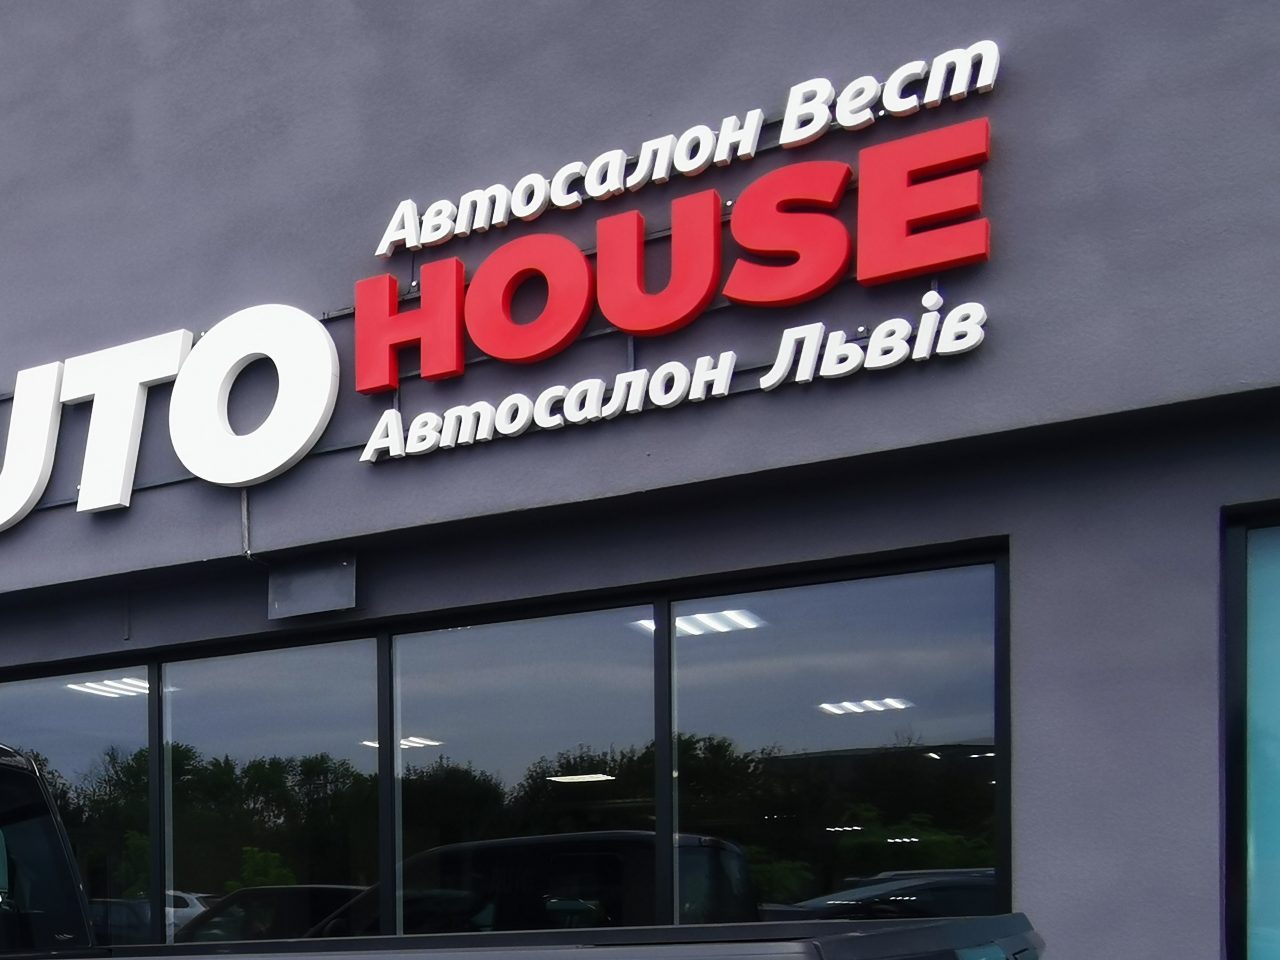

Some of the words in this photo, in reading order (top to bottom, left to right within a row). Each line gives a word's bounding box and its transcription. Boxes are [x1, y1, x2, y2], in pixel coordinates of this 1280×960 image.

[354, 117, 990, 394] HOUSE
[375, 109, 763, 257] Автосалон
[779, 40, 1001, 147] Вест
[359, 351, 738, 463] Автосалон
[760, 290, 988, 391] Львів
